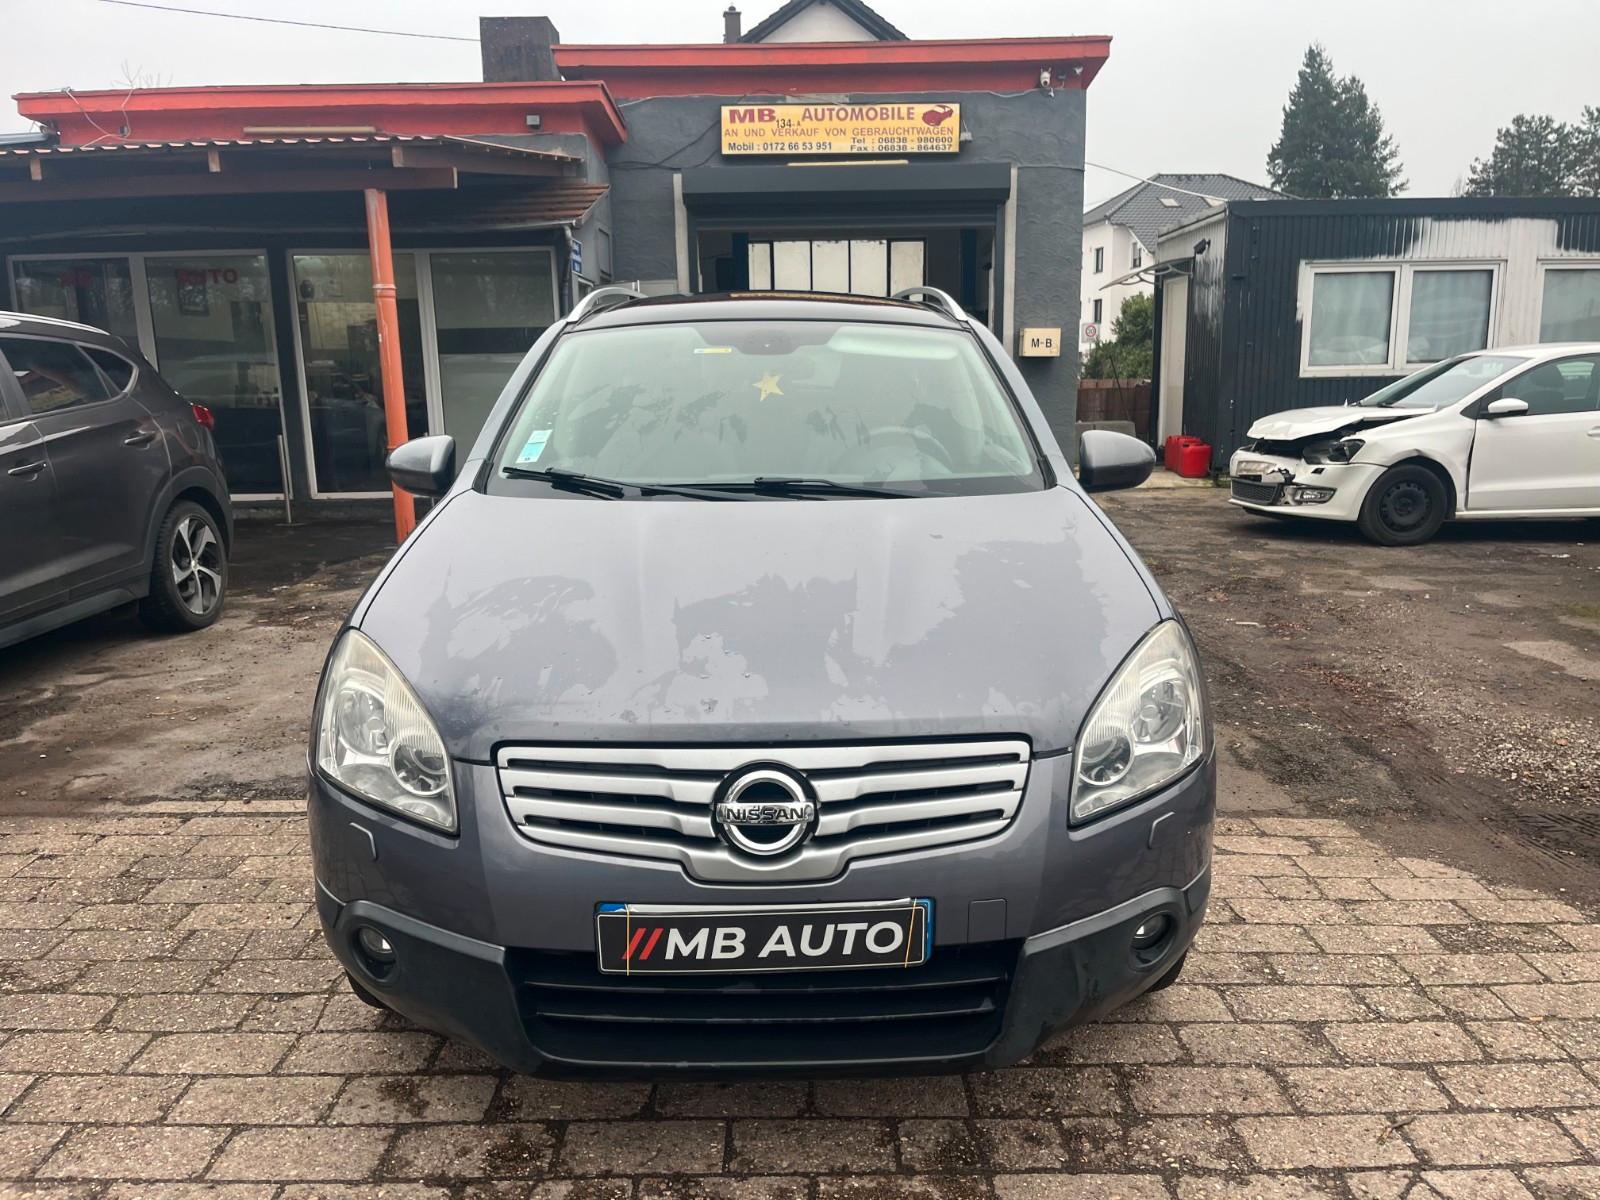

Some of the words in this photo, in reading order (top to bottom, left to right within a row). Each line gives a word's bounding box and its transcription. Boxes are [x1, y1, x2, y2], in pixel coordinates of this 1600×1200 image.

[729, 108, 777, 124] MB
[801, 106, 916, 122] AUTOMOBILE
[725, 128, 739, 137] AN
[744, 128, 766, 137] UND
[771, 128, 820, 137] VERKAUF
[825, 128, 847, 137] VON
[852, 127, 954, 136] GEBRAUCHTWAGEN
[728, 143, 755, 151] Mobil
[763, 143, 786, 151] 0172
[788, 143, 800, 151] 66
[802, 142, 814, 150] 53
[816, 142, 832, 150] 951
[1031, 338, 1052, 348] M-B
[724, 806, 805, 821] NISSAN
[758, 921, 904, 958] AUTO
